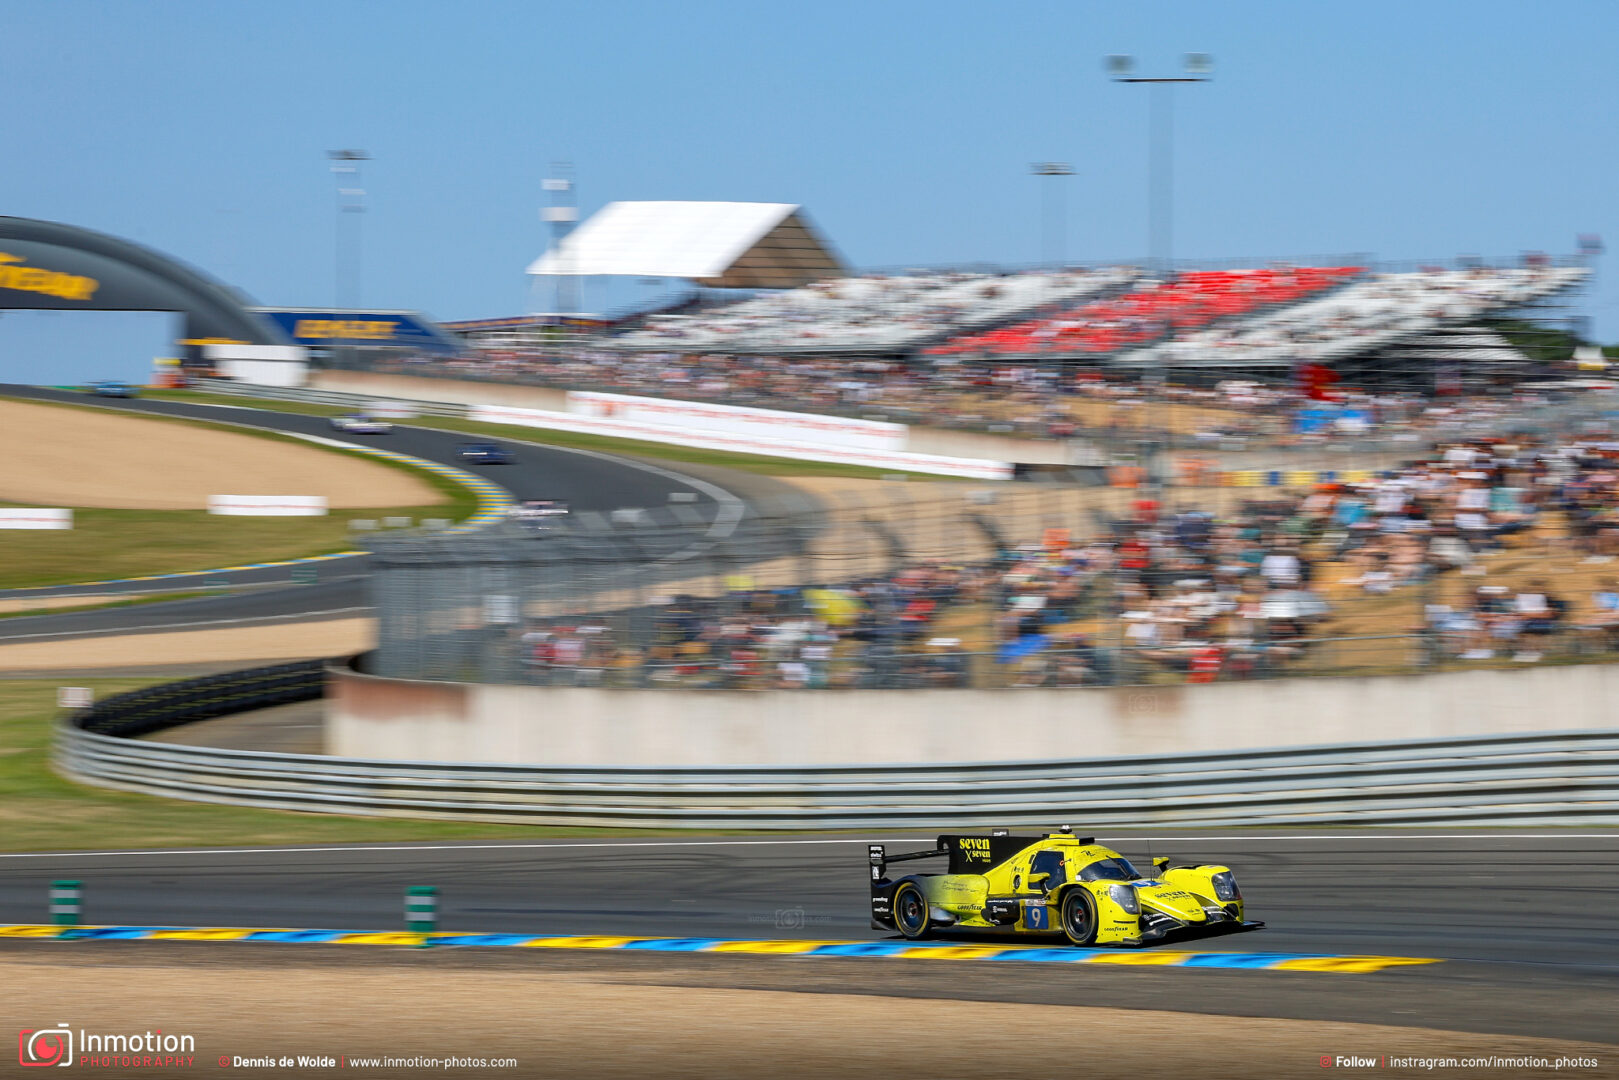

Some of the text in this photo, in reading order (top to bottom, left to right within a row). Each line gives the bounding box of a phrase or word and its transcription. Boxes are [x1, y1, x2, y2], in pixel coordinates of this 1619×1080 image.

[959, 838, 990, 850] seven
[972, 850, 991, 858] seven
[957, 903, 983, 911] GOODYEAR
[1031, 907, 1042, 927] 9
